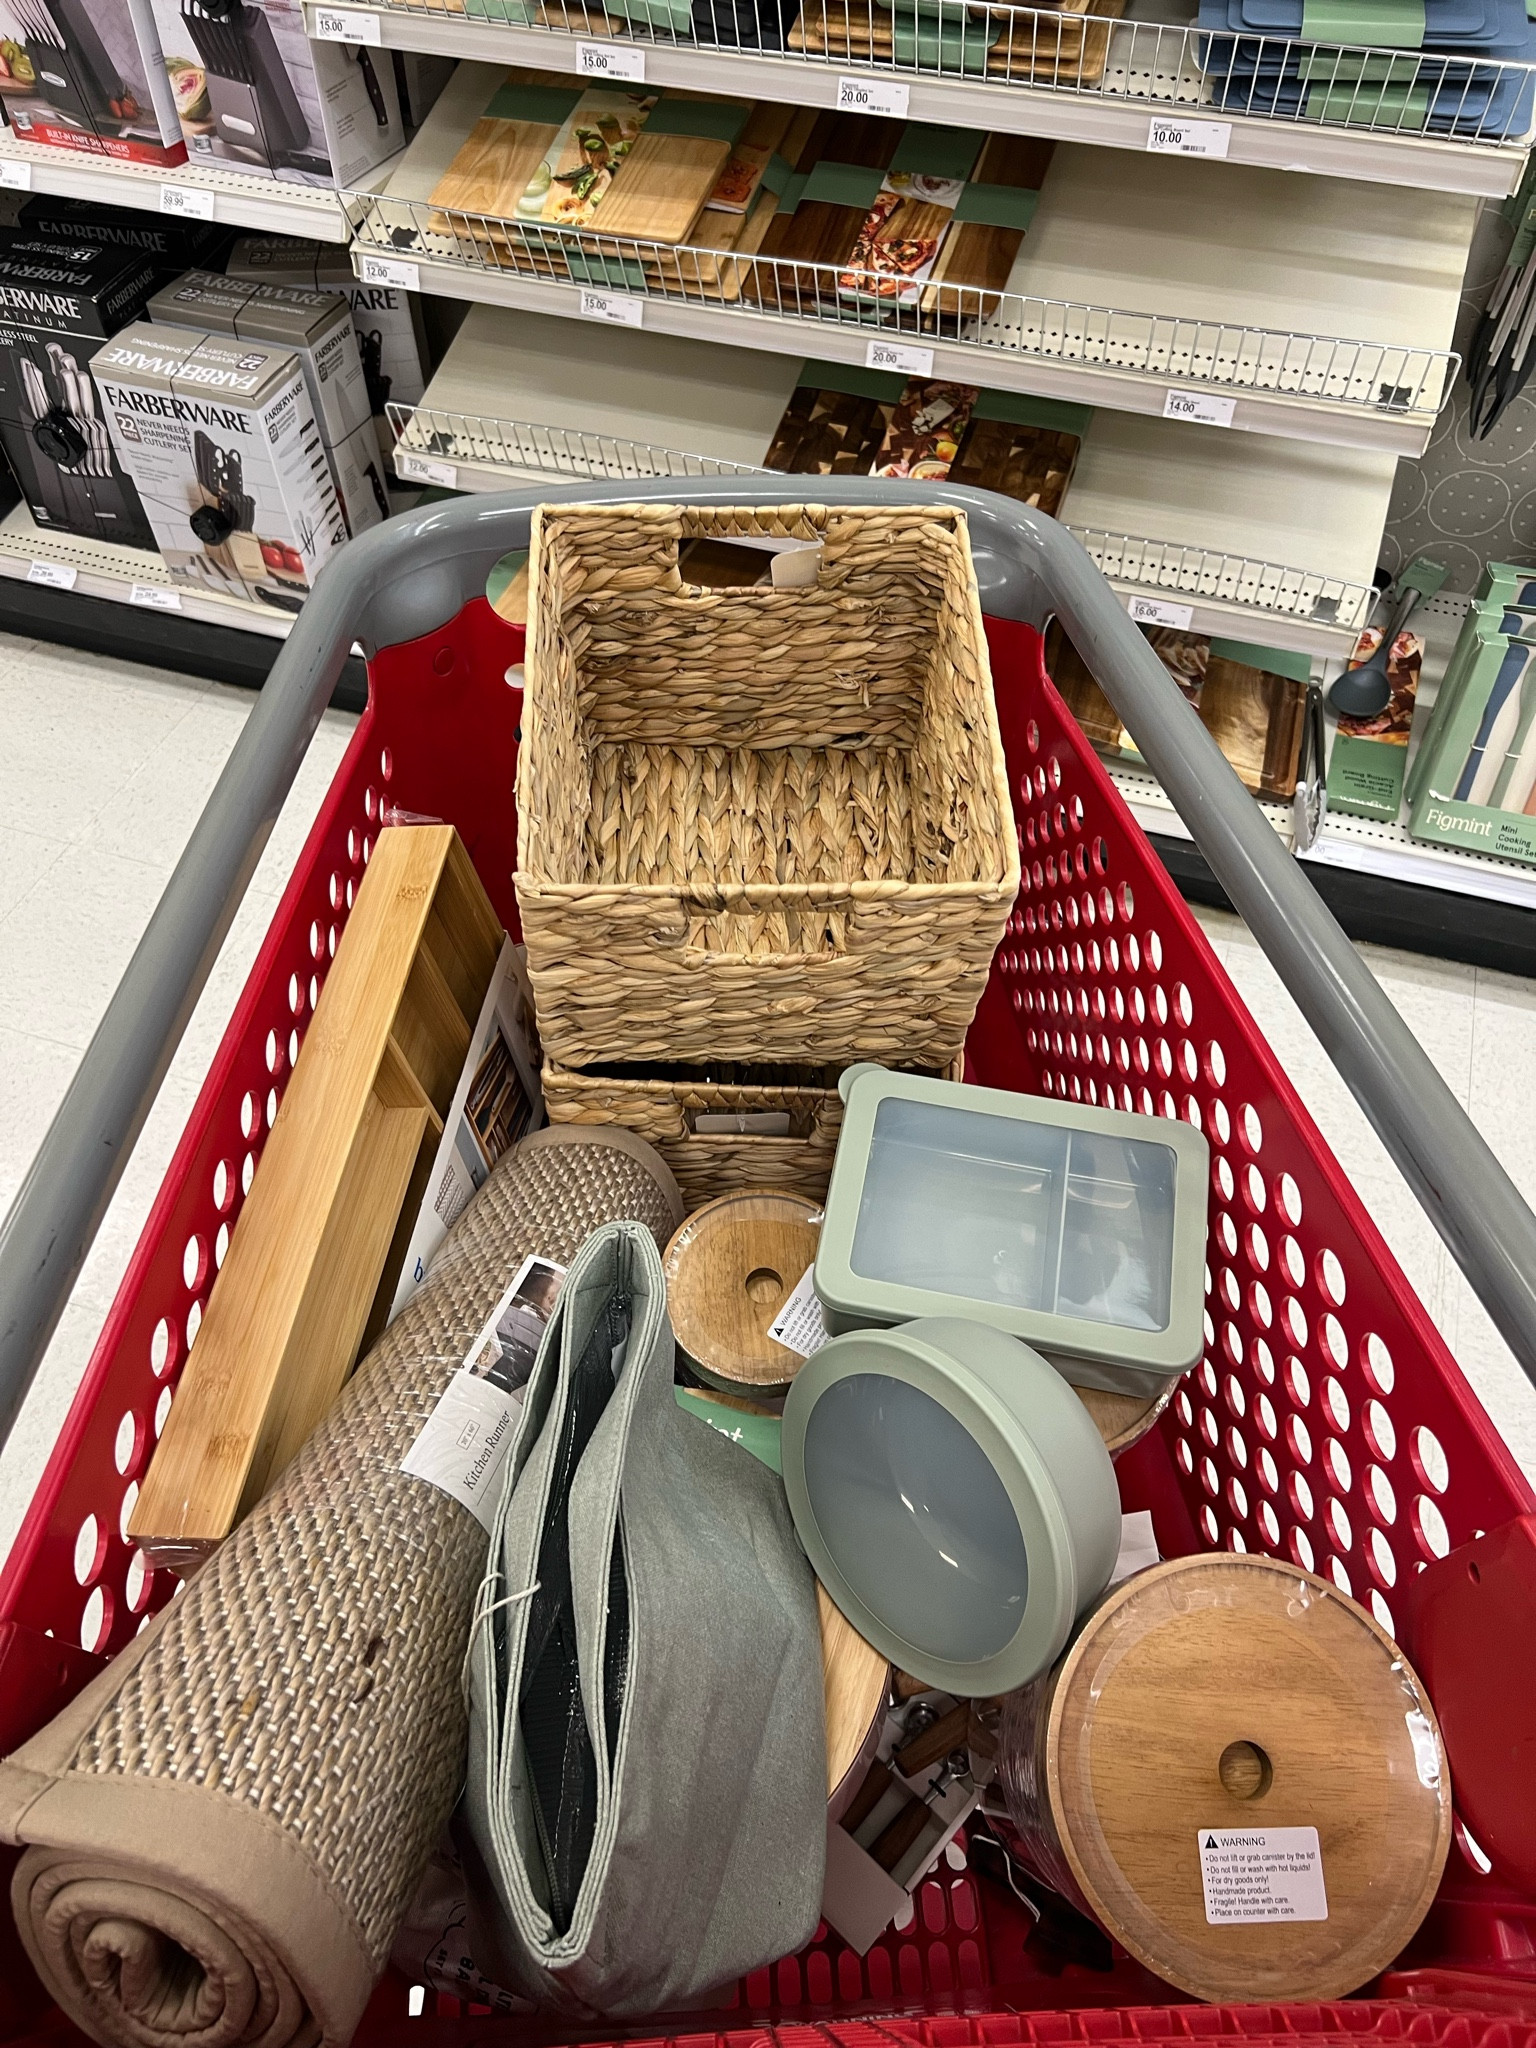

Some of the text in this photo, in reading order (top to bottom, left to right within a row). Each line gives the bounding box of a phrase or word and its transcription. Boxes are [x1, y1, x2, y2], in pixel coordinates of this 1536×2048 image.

[319, 20, 343, 32] 15.00
[582, 55, 608, 68] 15.00
[841, 89, 868, 103] 20.00
[1153, 130, 1182, 143] 10.00
[70, 251, 91, 260] 15
[366, 266, 388, 278] 12.00
[184, 272, 329, 307] FARBERWARE
[0, 285, 82, 319] ERWARE
[585, 298, 607, 310] 15.00
[873, 351, 897, 363] 20.00
[103, 348, 259, 391] FARBERWARE
[103, 385, 253, 435] FARBERWARE
[1169, 401, 1195, 413] 14.00
[116, 415, 138, 433] 22
[136, 418, 190, 436] NEVER NEEDS
[140, 428, 191, 445] SHARPENING
[143, 437, 177, 450] CUTLERY
[1134, 606, 1157, 617] 16.00
[1426, 808, 1493, 837] Figmint
[1501, 824, 1518, 835] Mini
[1498, 833, 1532, 849] Cooking
[1495, 842, 1523, 855] Utensil
[780, 1297, 802, 1326] WARNING
[463, 1410, 510, 1490] Kitchen Runner
[1220, 1837, 1266, 1847] WARNING
[1209, 1854, 1219, 1862] Do
[1220, 1854, 1230, 1862] not
[1230, 1853, 1239, 1862] lift
[1246, 1853, 1261, 1863] grab
[1261, 1853, 1286, 1862] canister
[1286, 1853, 1294, 1862] by
[1295, 1852, 1306, 1860] the
[1210, 1865, 1220, 1874] Do
[1220, 1865, 1231, 1873] not
[1231, 1865, 1239, 1873] fill
[1247, 1865, 1263, 1873] wash
[1264, 1864, 1278, 1872] with
[1278, 1863, 1288, 1872] hot
[1289, 1863, 1311, 1872] liquids!
[1211, 1875, 1269, 1885] For dry goods only!
[1212, 1886, 1272, 1896] Handmade product.
[1213, 1897, 1237, 1908] Fragile!
[1238, 1896, 1260, 1905] Handle
[1261, 1896, 1274, 1905] with
[1215, 1908, 1232, 1917] Place
[1242, 1907, 1266, 1916] counter
[1267, 1907, 1280, 1915] with
